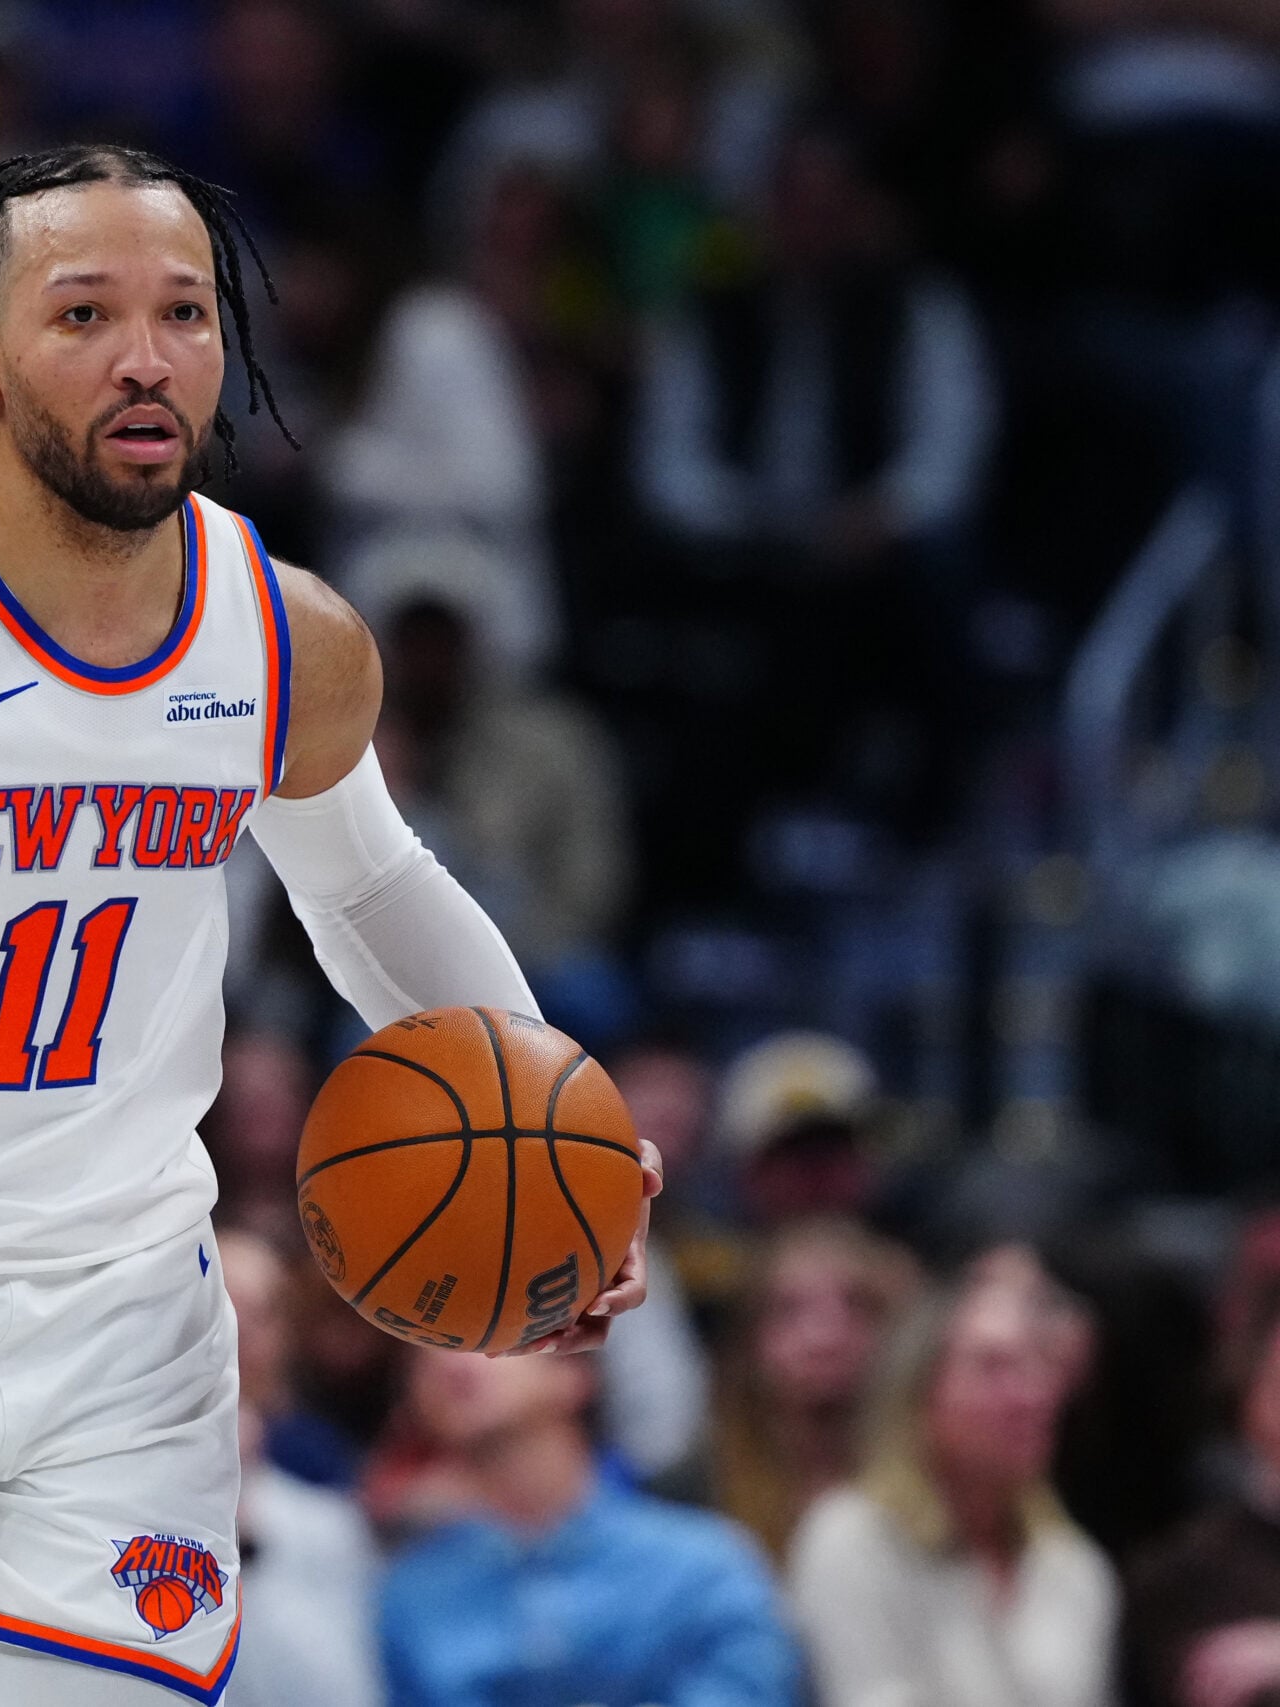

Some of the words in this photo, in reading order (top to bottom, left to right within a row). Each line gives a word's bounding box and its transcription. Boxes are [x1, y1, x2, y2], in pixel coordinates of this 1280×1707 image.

[169, 691, 217, 703] experience
[166, 703, 202, 722] abu
[90, 782, 259, 870] YORK
[435, 1273, 458, 1300] OFFICIAL
[154, 1533, 176, 1542] NEW
[110, 1535, 223, 1607] KNICKS
